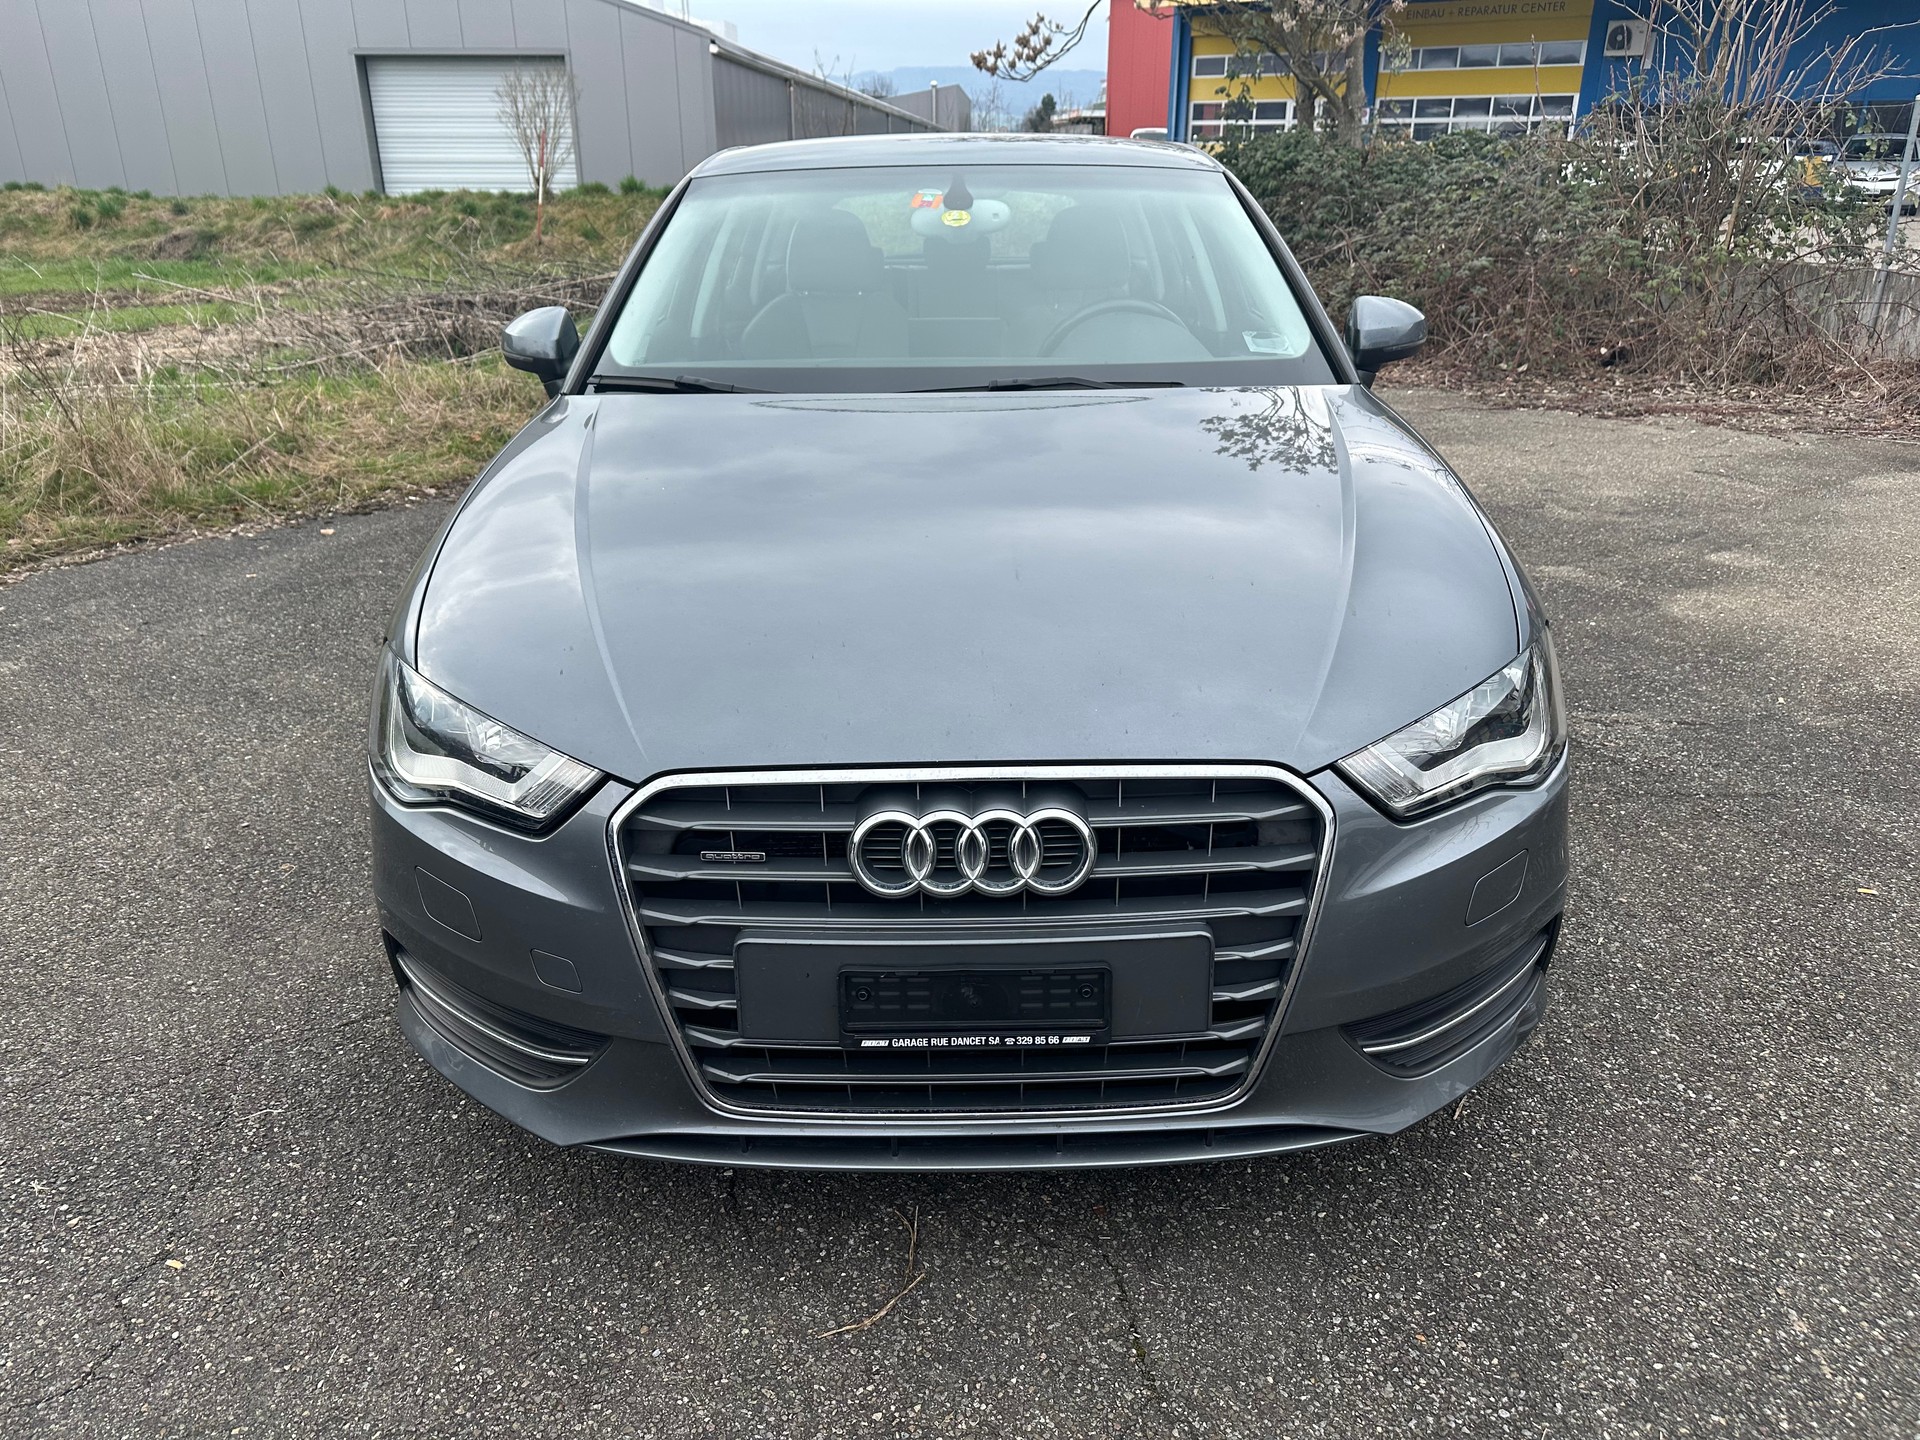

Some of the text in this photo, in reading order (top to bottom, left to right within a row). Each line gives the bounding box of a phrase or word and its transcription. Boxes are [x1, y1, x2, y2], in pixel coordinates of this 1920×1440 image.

[1406, 8, 1445, 20] EINBAU
[1457, 4, 1517, 16] REPARATUR
[1521, 1, 1566, 13] CENTER
[705, 853, 760, 861] quattro
[892, 1038, 929, 1047] GARAGE
[931, 1037, 949, 1046] RUE
[951, 1036, 987, 1046] DANCET
[1016, 1036, 1033, 1045] 329
[1035, 1036, 1047, 1045] 85
[1048, 1036, 1060, 1044] 66
